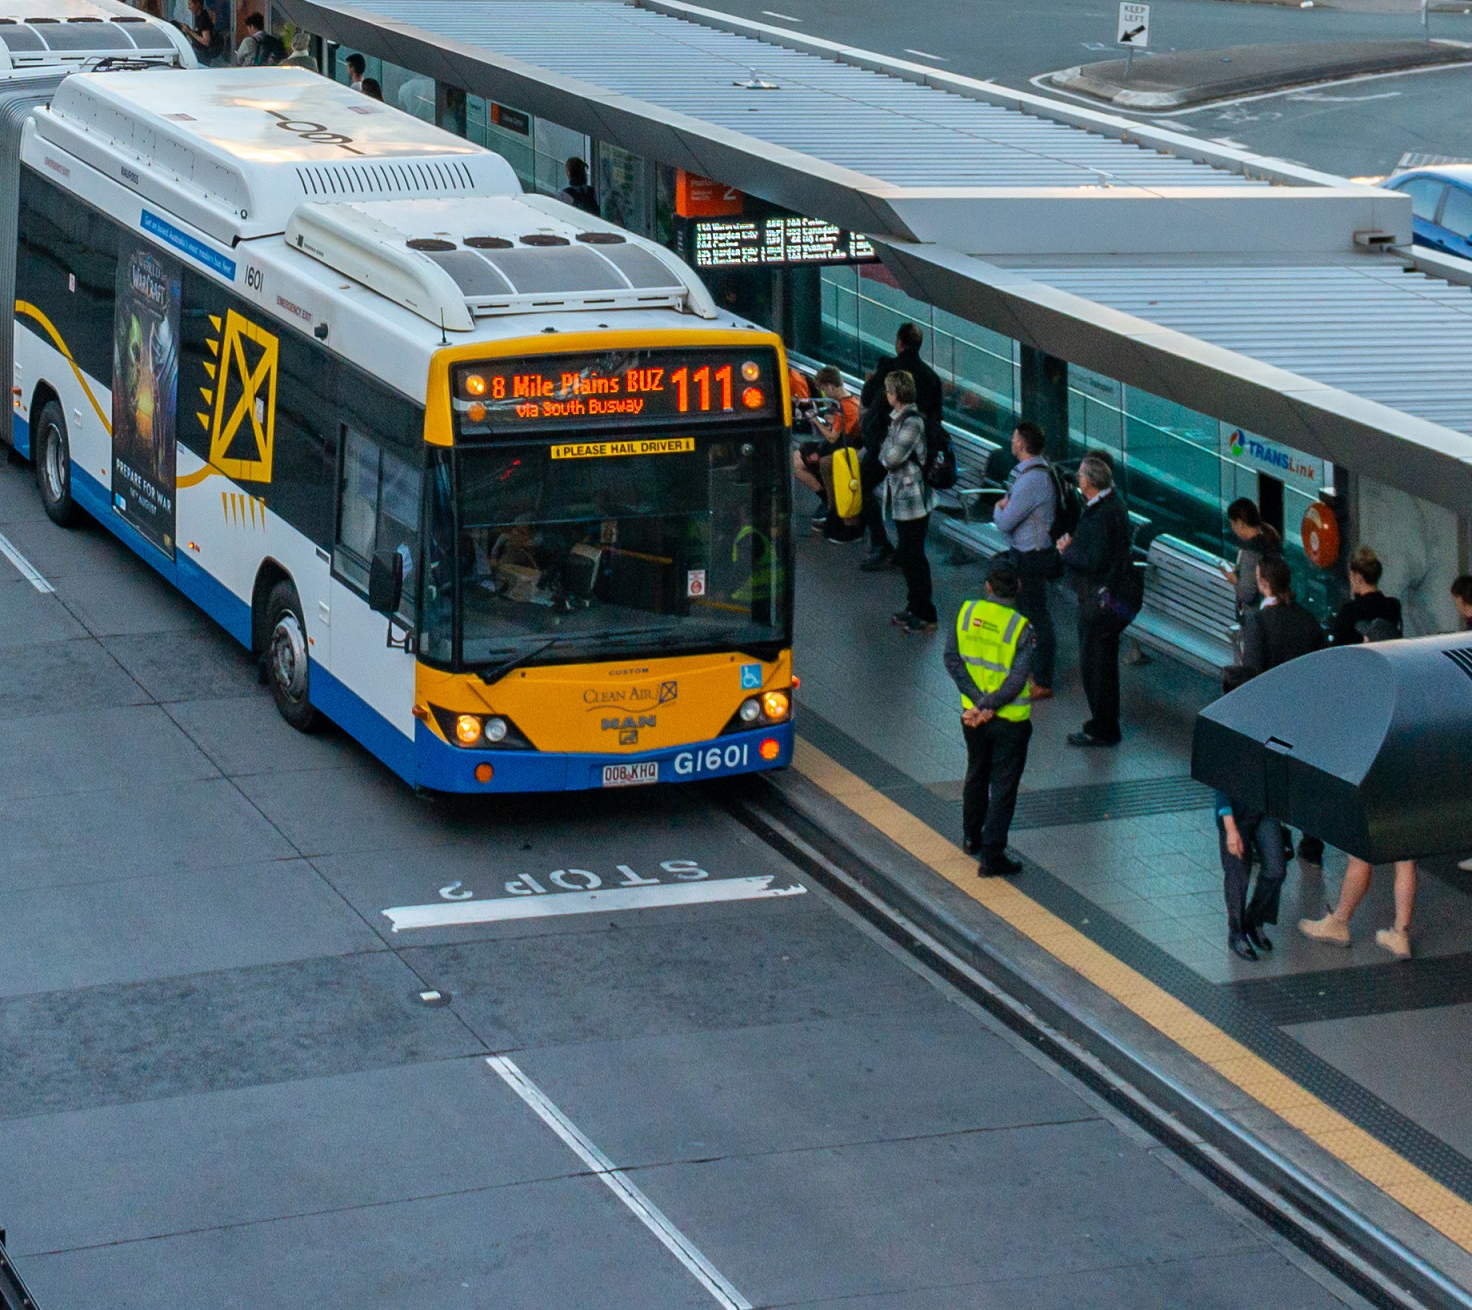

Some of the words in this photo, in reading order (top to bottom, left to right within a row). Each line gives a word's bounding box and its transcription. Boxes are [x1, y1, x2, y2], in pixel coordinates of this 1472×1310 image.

[1124, 4, 1146, 14] KEEP
[1124, 13, 1144, 23] LEFT
[244, 265, 264, 293] 1601
[492, 375, 506, 399] 8
[512, 373, 555, 398] Mile
[560, 371, 621, 397] Plains
[626, 367, 665, 393] BUZ
[670, 363, 735, 412] 111
[516, 402, 539, 418] via
[542, 399, 586, 417] South
[587, 397, 644, 416] Busway
[563, 444, 606, 457] PLEASE
[610, 443, 637, 454] HAIL
[640, 440, 683, 453] DRIVER
[1248, 440, 1315, 480] TRANSLink
[116, 458, 142, 489] PREPARE
[143, 480, 156, 501] FOR
[156, 490, 172, 514] WAR
[609, 667, 649, 676] CUSTOM
[601, 715, 656, 731] MAN
[674, 744, 749, 775] G1601
[631, 763, 657, 778] KHQ
[505, 860, 709, 895] STOP
